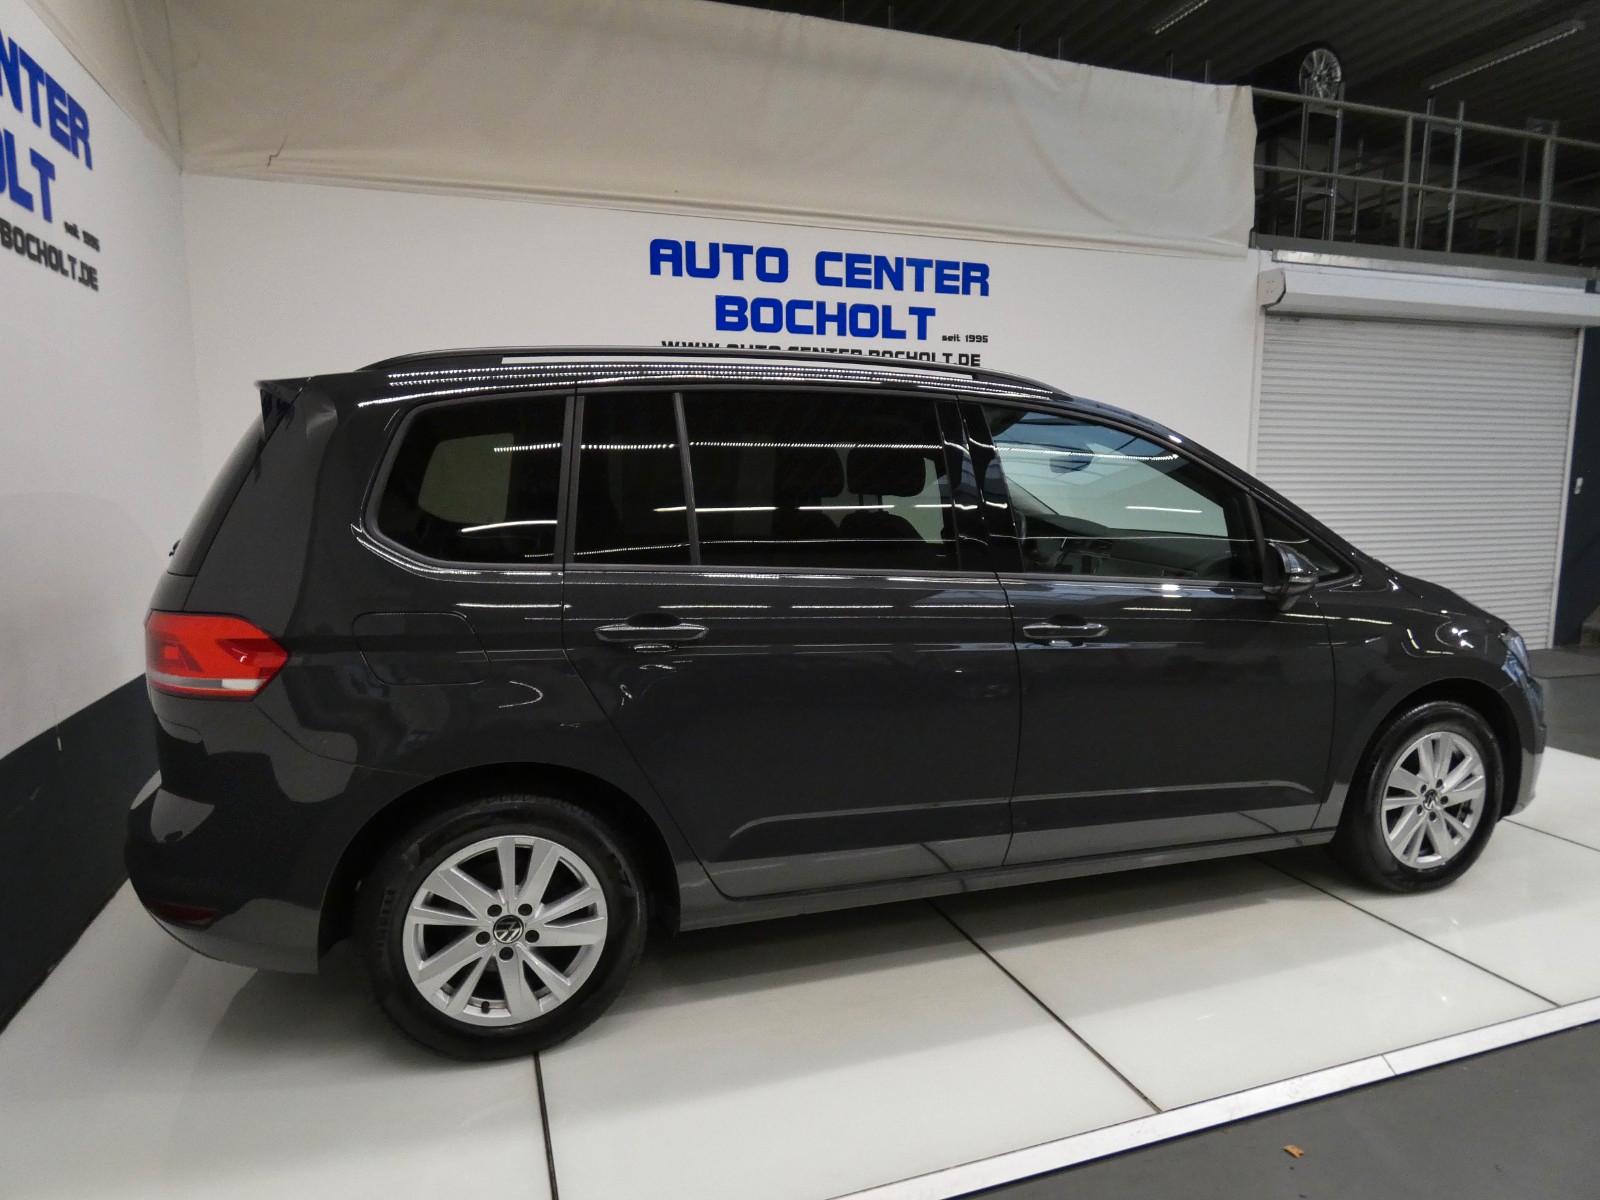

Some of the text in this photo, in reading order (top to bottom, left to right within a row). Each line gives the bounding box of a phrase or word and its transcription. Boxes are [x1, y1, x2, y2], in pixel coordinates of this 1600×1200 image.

[0, 129, 54, 223] LT
[650, 238, 990, 297] AUTO CENTER
[715, 294, 936, 341] BOCHOLT
[941, 333, 989, 343] seit 1995
